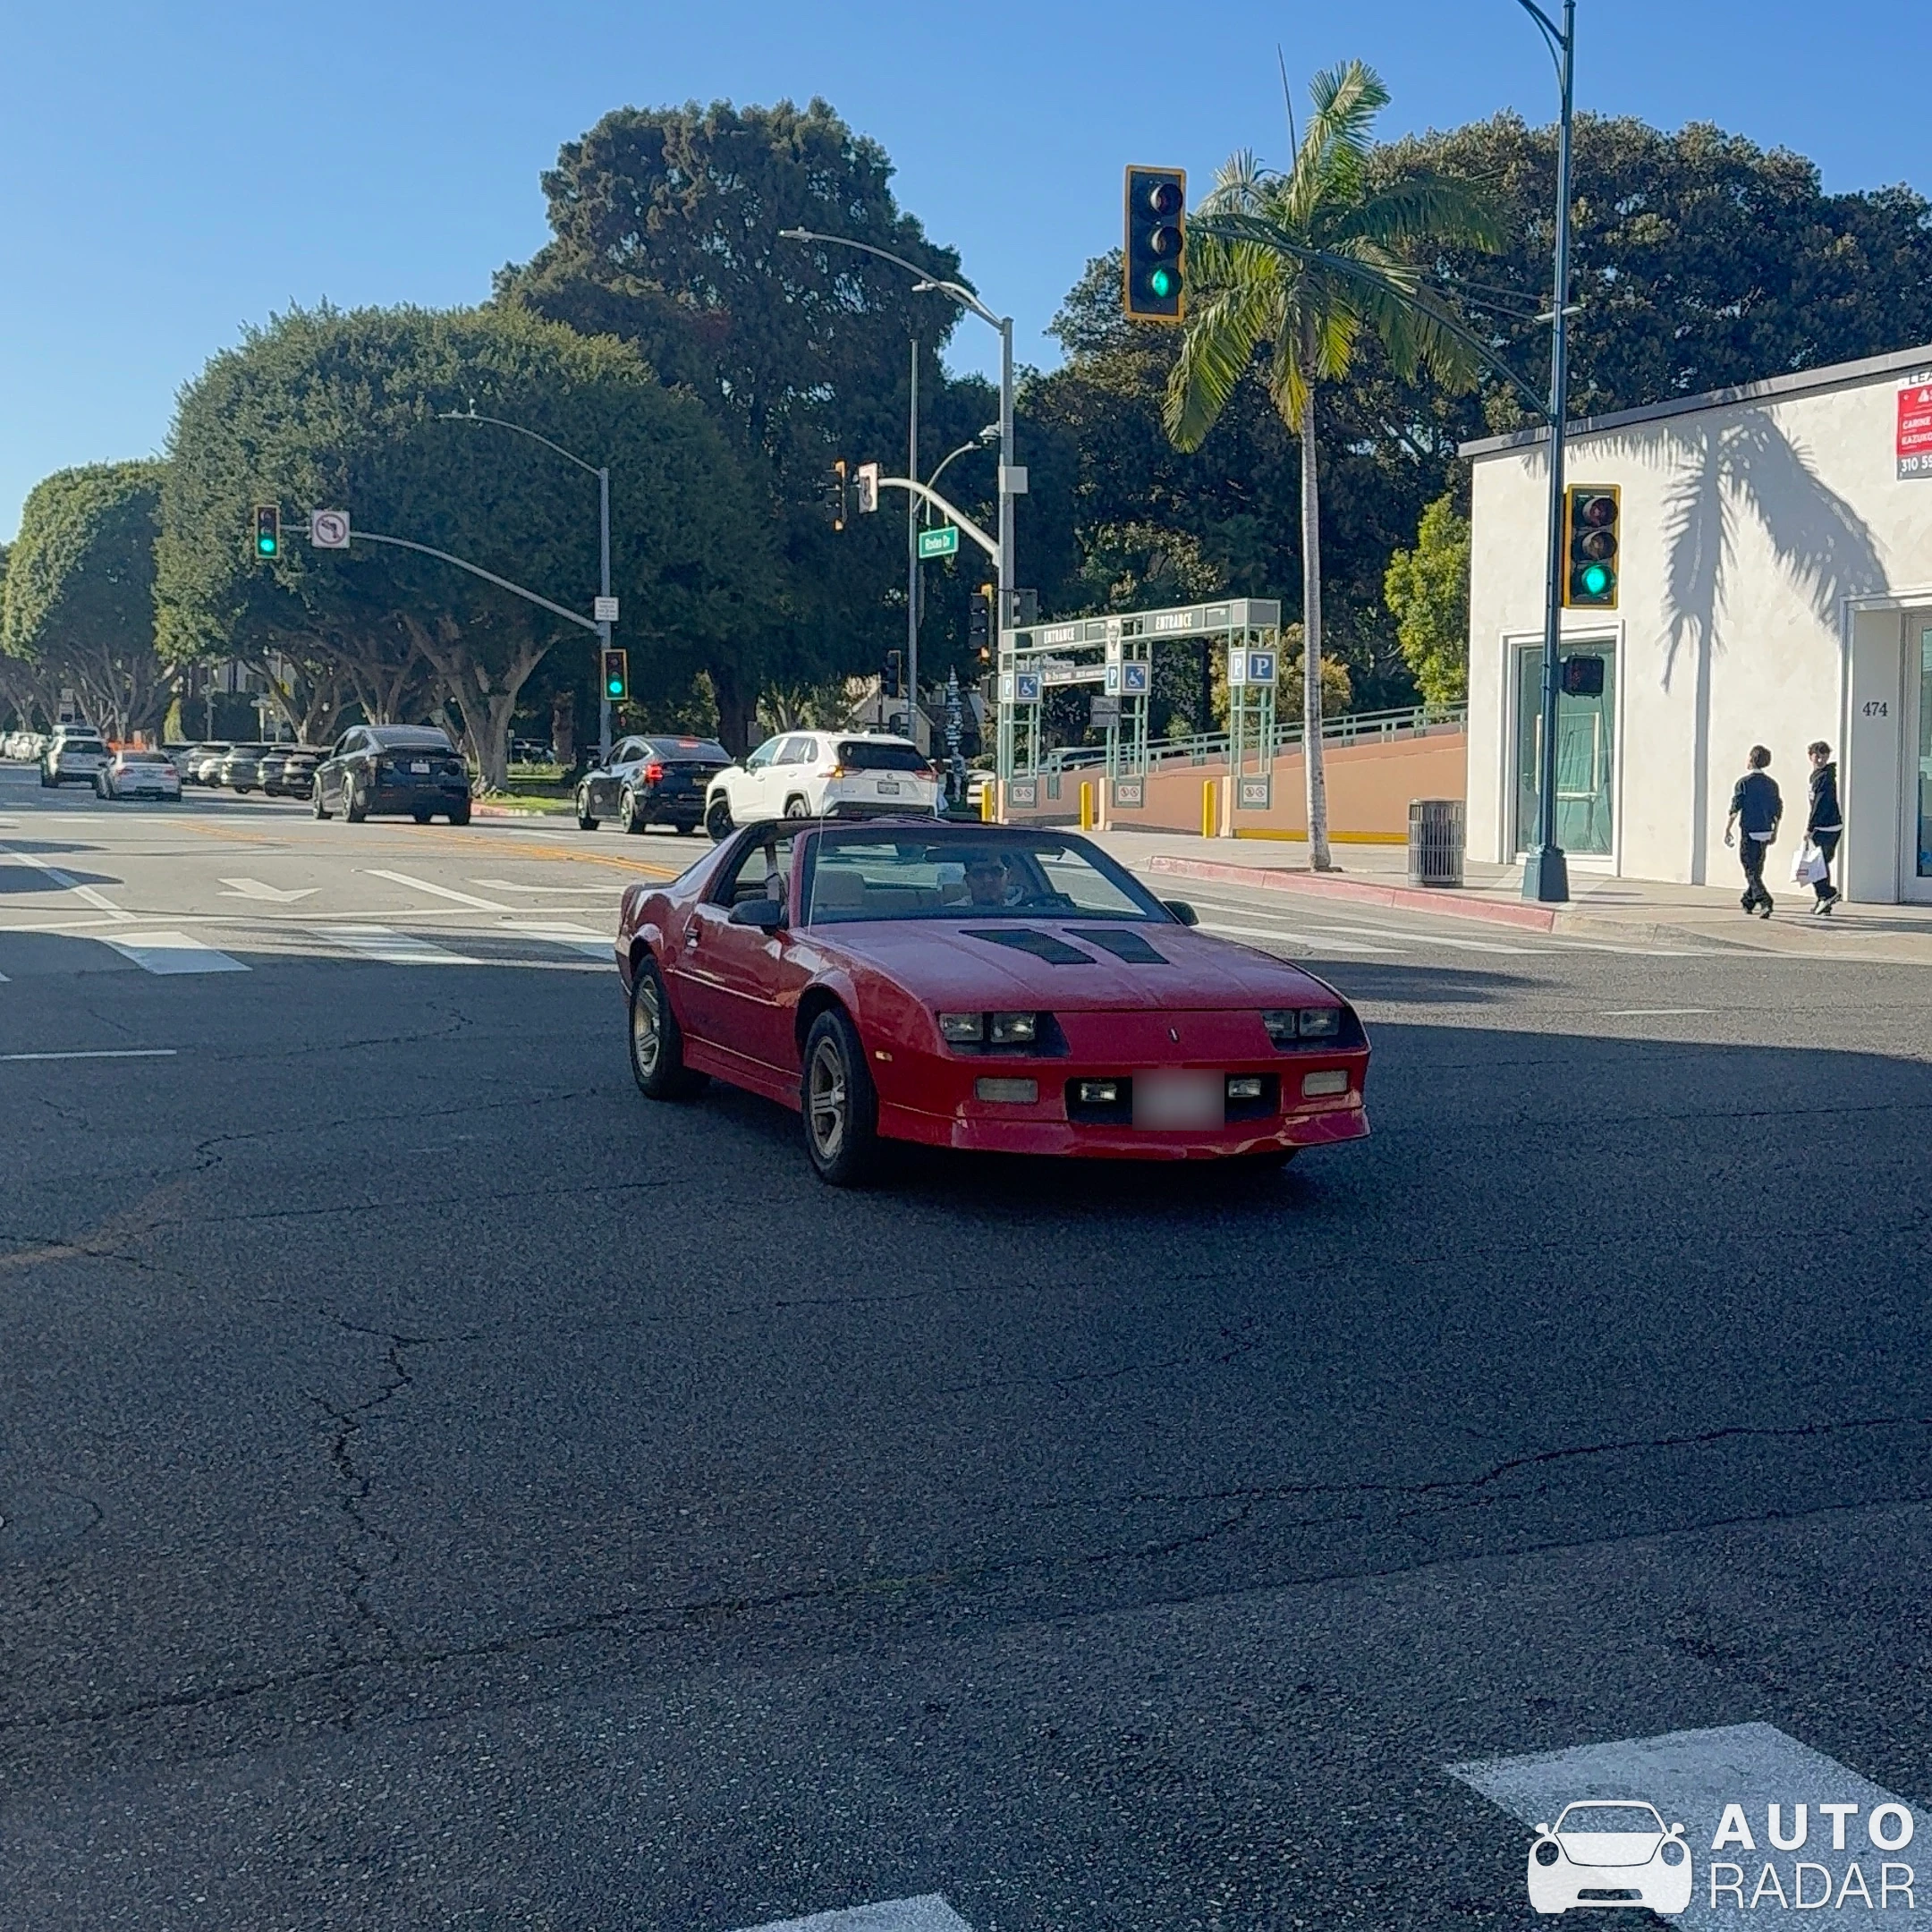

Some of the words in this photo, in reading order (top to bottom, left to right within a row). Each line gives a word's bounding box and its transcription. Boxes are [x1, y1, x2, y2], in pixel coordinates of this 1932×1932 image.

[1901, 457, 1919, 472] 310
[1156, 613, 1192, 630] ENTRANCE
[1044, 627, 1075, 644] ENTRANCE
[1234, 658, 1241, 676] P
[1256, 657, 1268, 675] P
[1109, 668, 1117, 686] P
[1004, 679, 1011, 695] P
[1862, 701, 1888, 716] 474
